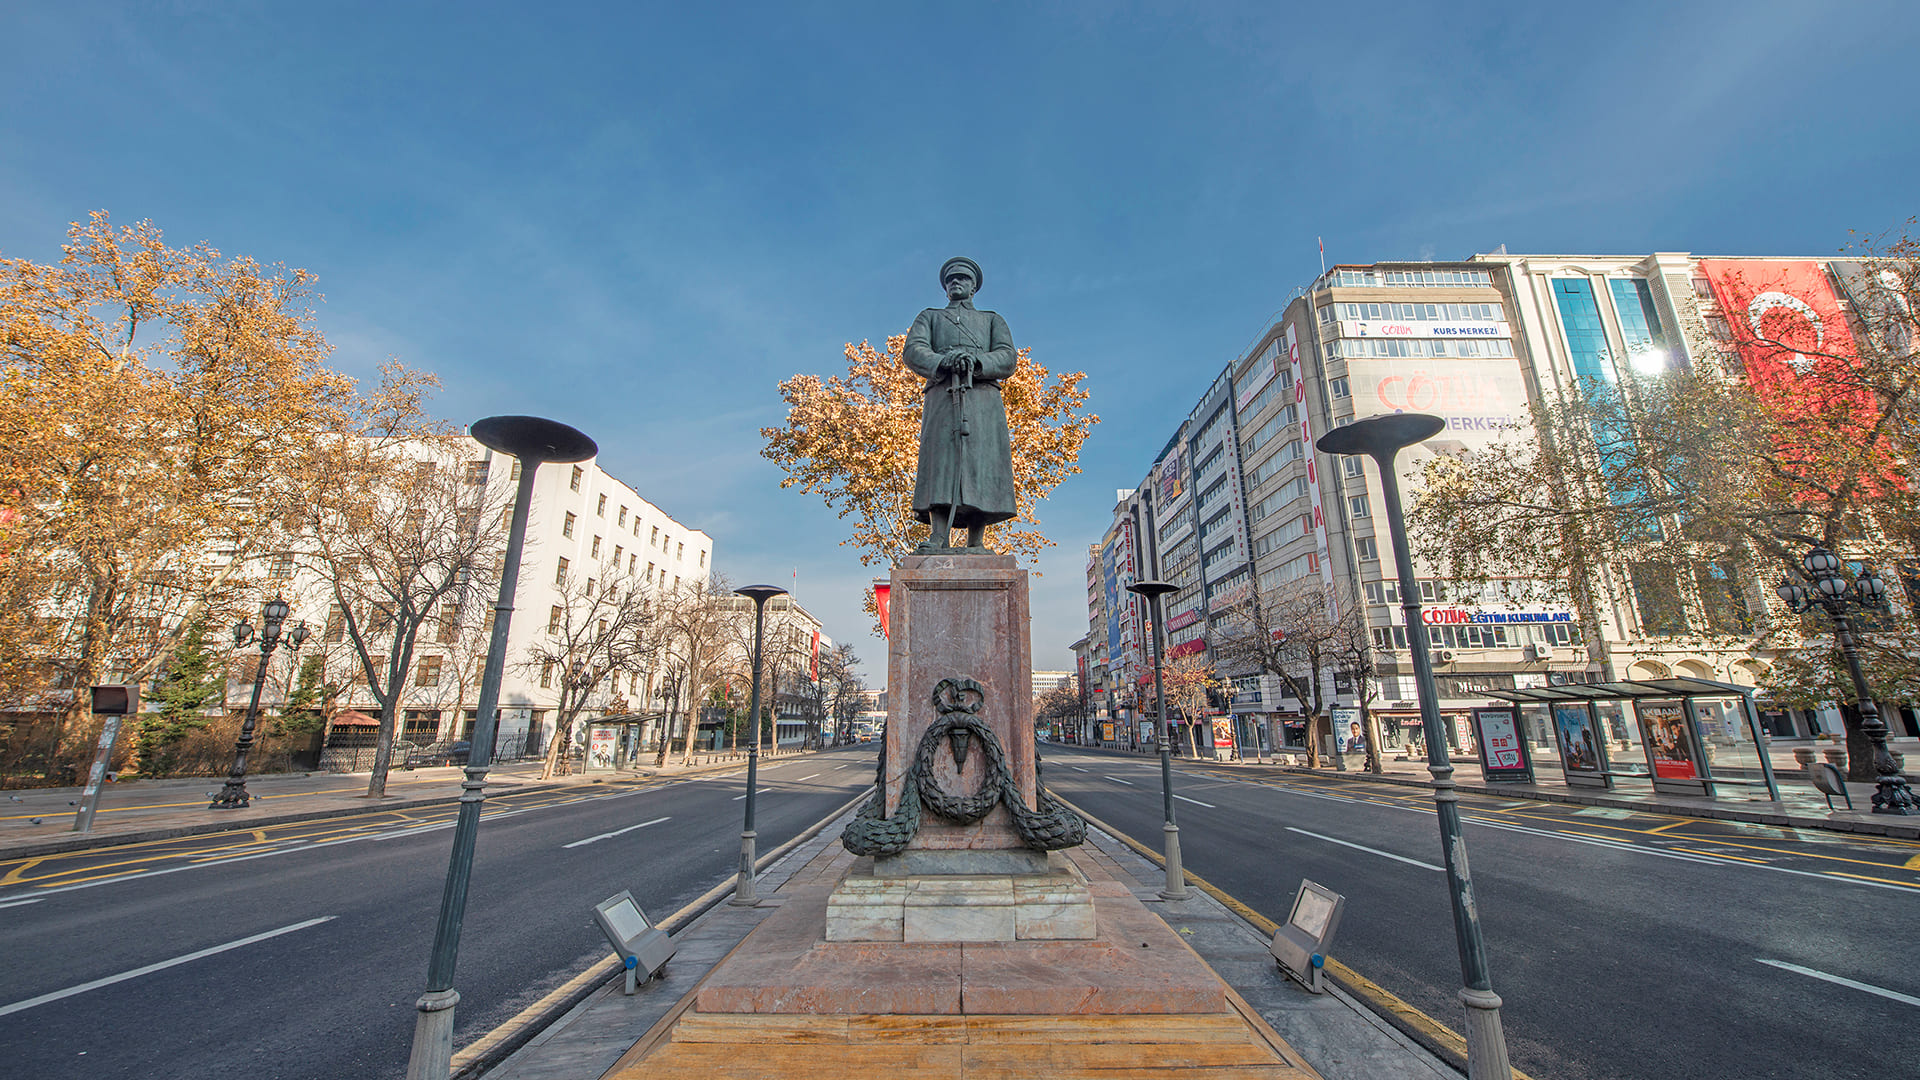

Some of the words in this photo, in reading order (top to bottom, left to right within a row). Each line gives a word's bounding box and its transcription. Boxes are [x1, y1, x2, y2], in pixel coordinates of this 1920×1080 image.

[1381, 325, 1413, 336] ÇÖZÜM
[1433, 327, 1458, 335] KURS
[1459, 325, 1498, 335] MERKEZİ
[1290, 343, 1323, 529] ÇÖZÜM
[1130, 602, 1139, 650] EĞİTİM
[1422, 606, 1469, 626] ÇÖZÜM
[1470, 611, 1507, 624] EĞİTİM
[1507, 612, 1571, 623] KURUMLARI
